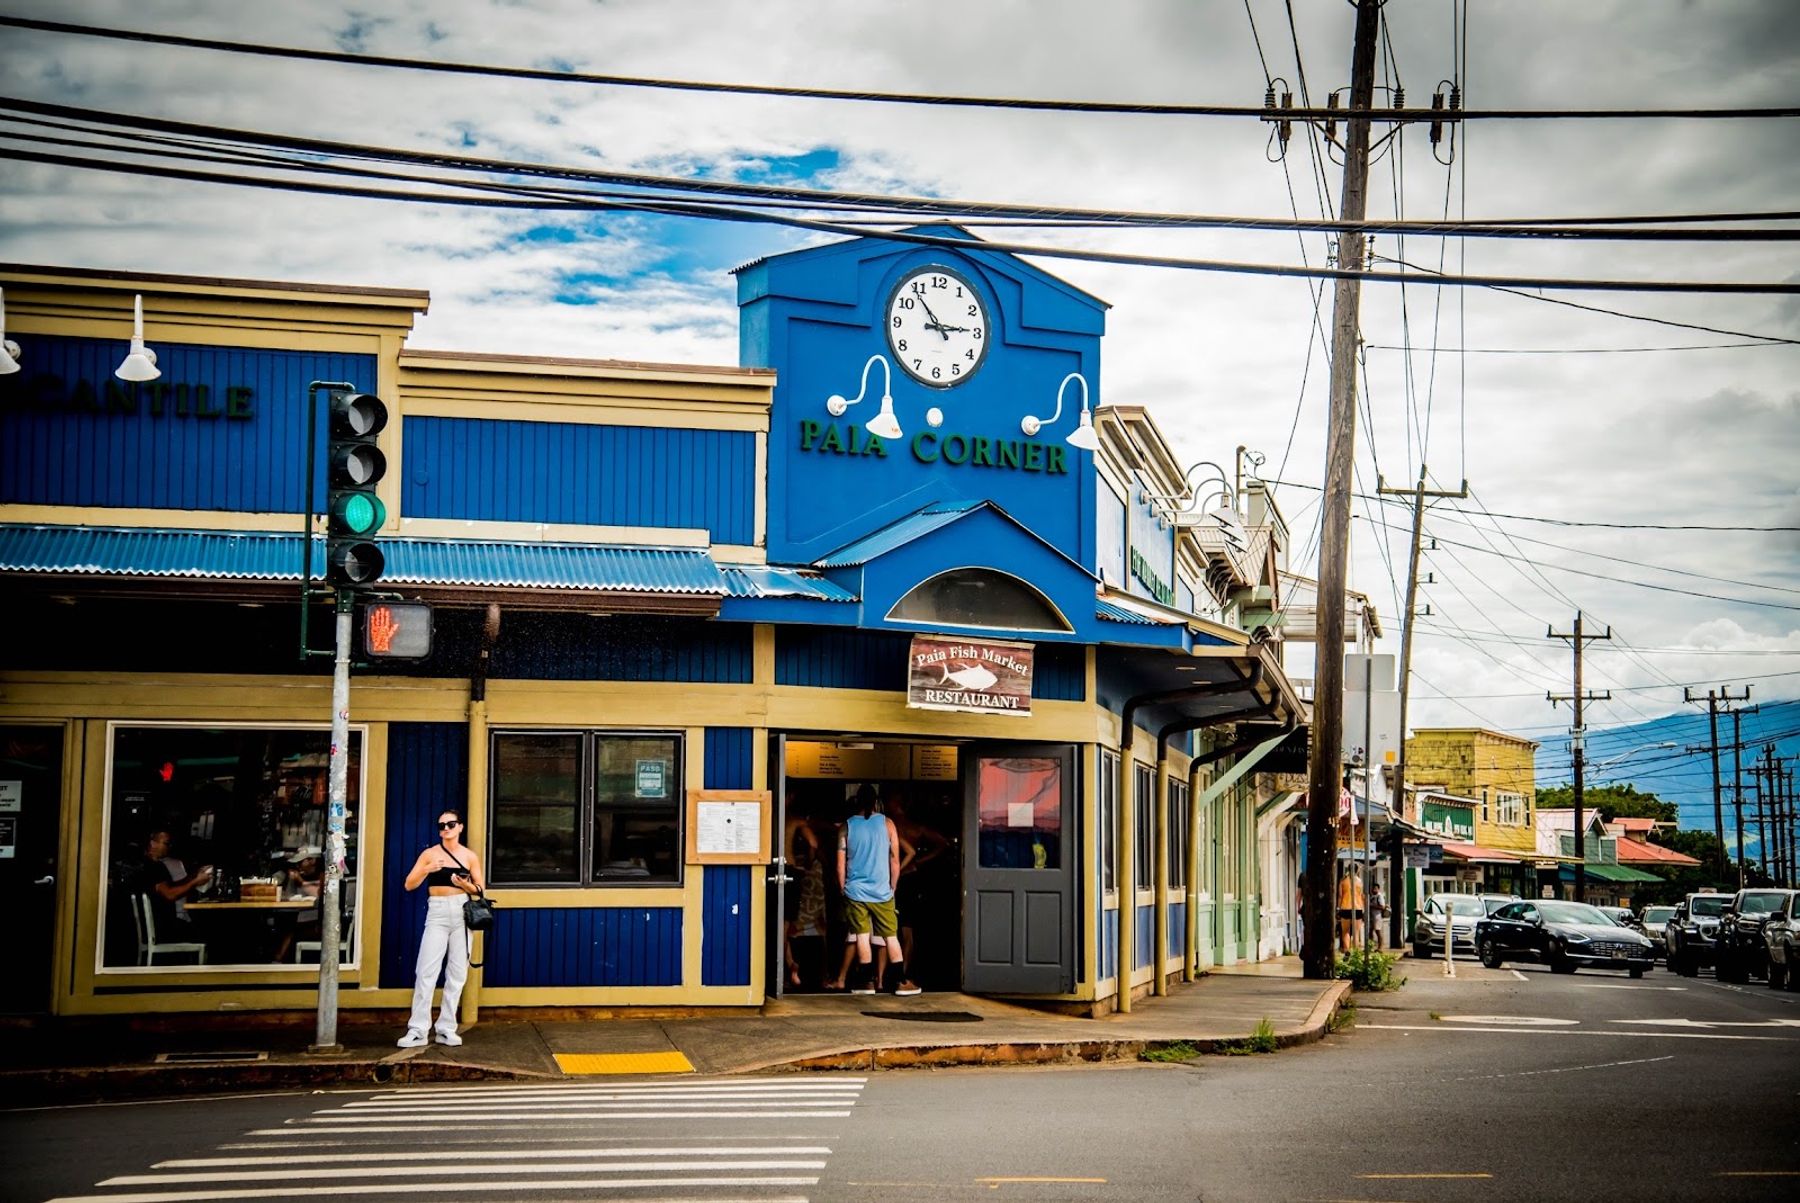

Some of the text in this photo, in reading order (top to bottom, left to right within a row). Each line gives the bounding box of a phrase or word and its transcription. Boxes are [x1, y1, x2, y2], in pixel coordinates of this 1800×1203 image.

[912, 281, 926, 294] 11
[931, 276, 947, 289] 12
[956, 287, 962, 298] 1
[899, 297, 915, 310] 10
[968, 305, 977, 316] 2
[893, 317, 902, 328] 9
[973, 327, 982, 339] 3
[898, 340, 907, 351] 8
[965, 349, 975, 360] 4
[914, 359, 922, 370] 7
[952, 364, 960, 375] 5
[932, 367, 940, 378] 6
[801, 420, 1069, 474] PAIA CORNER
[917, 646, 1029, 676] Paia Fish Market
[925, 688, 1020, 709] RESTAURANT
